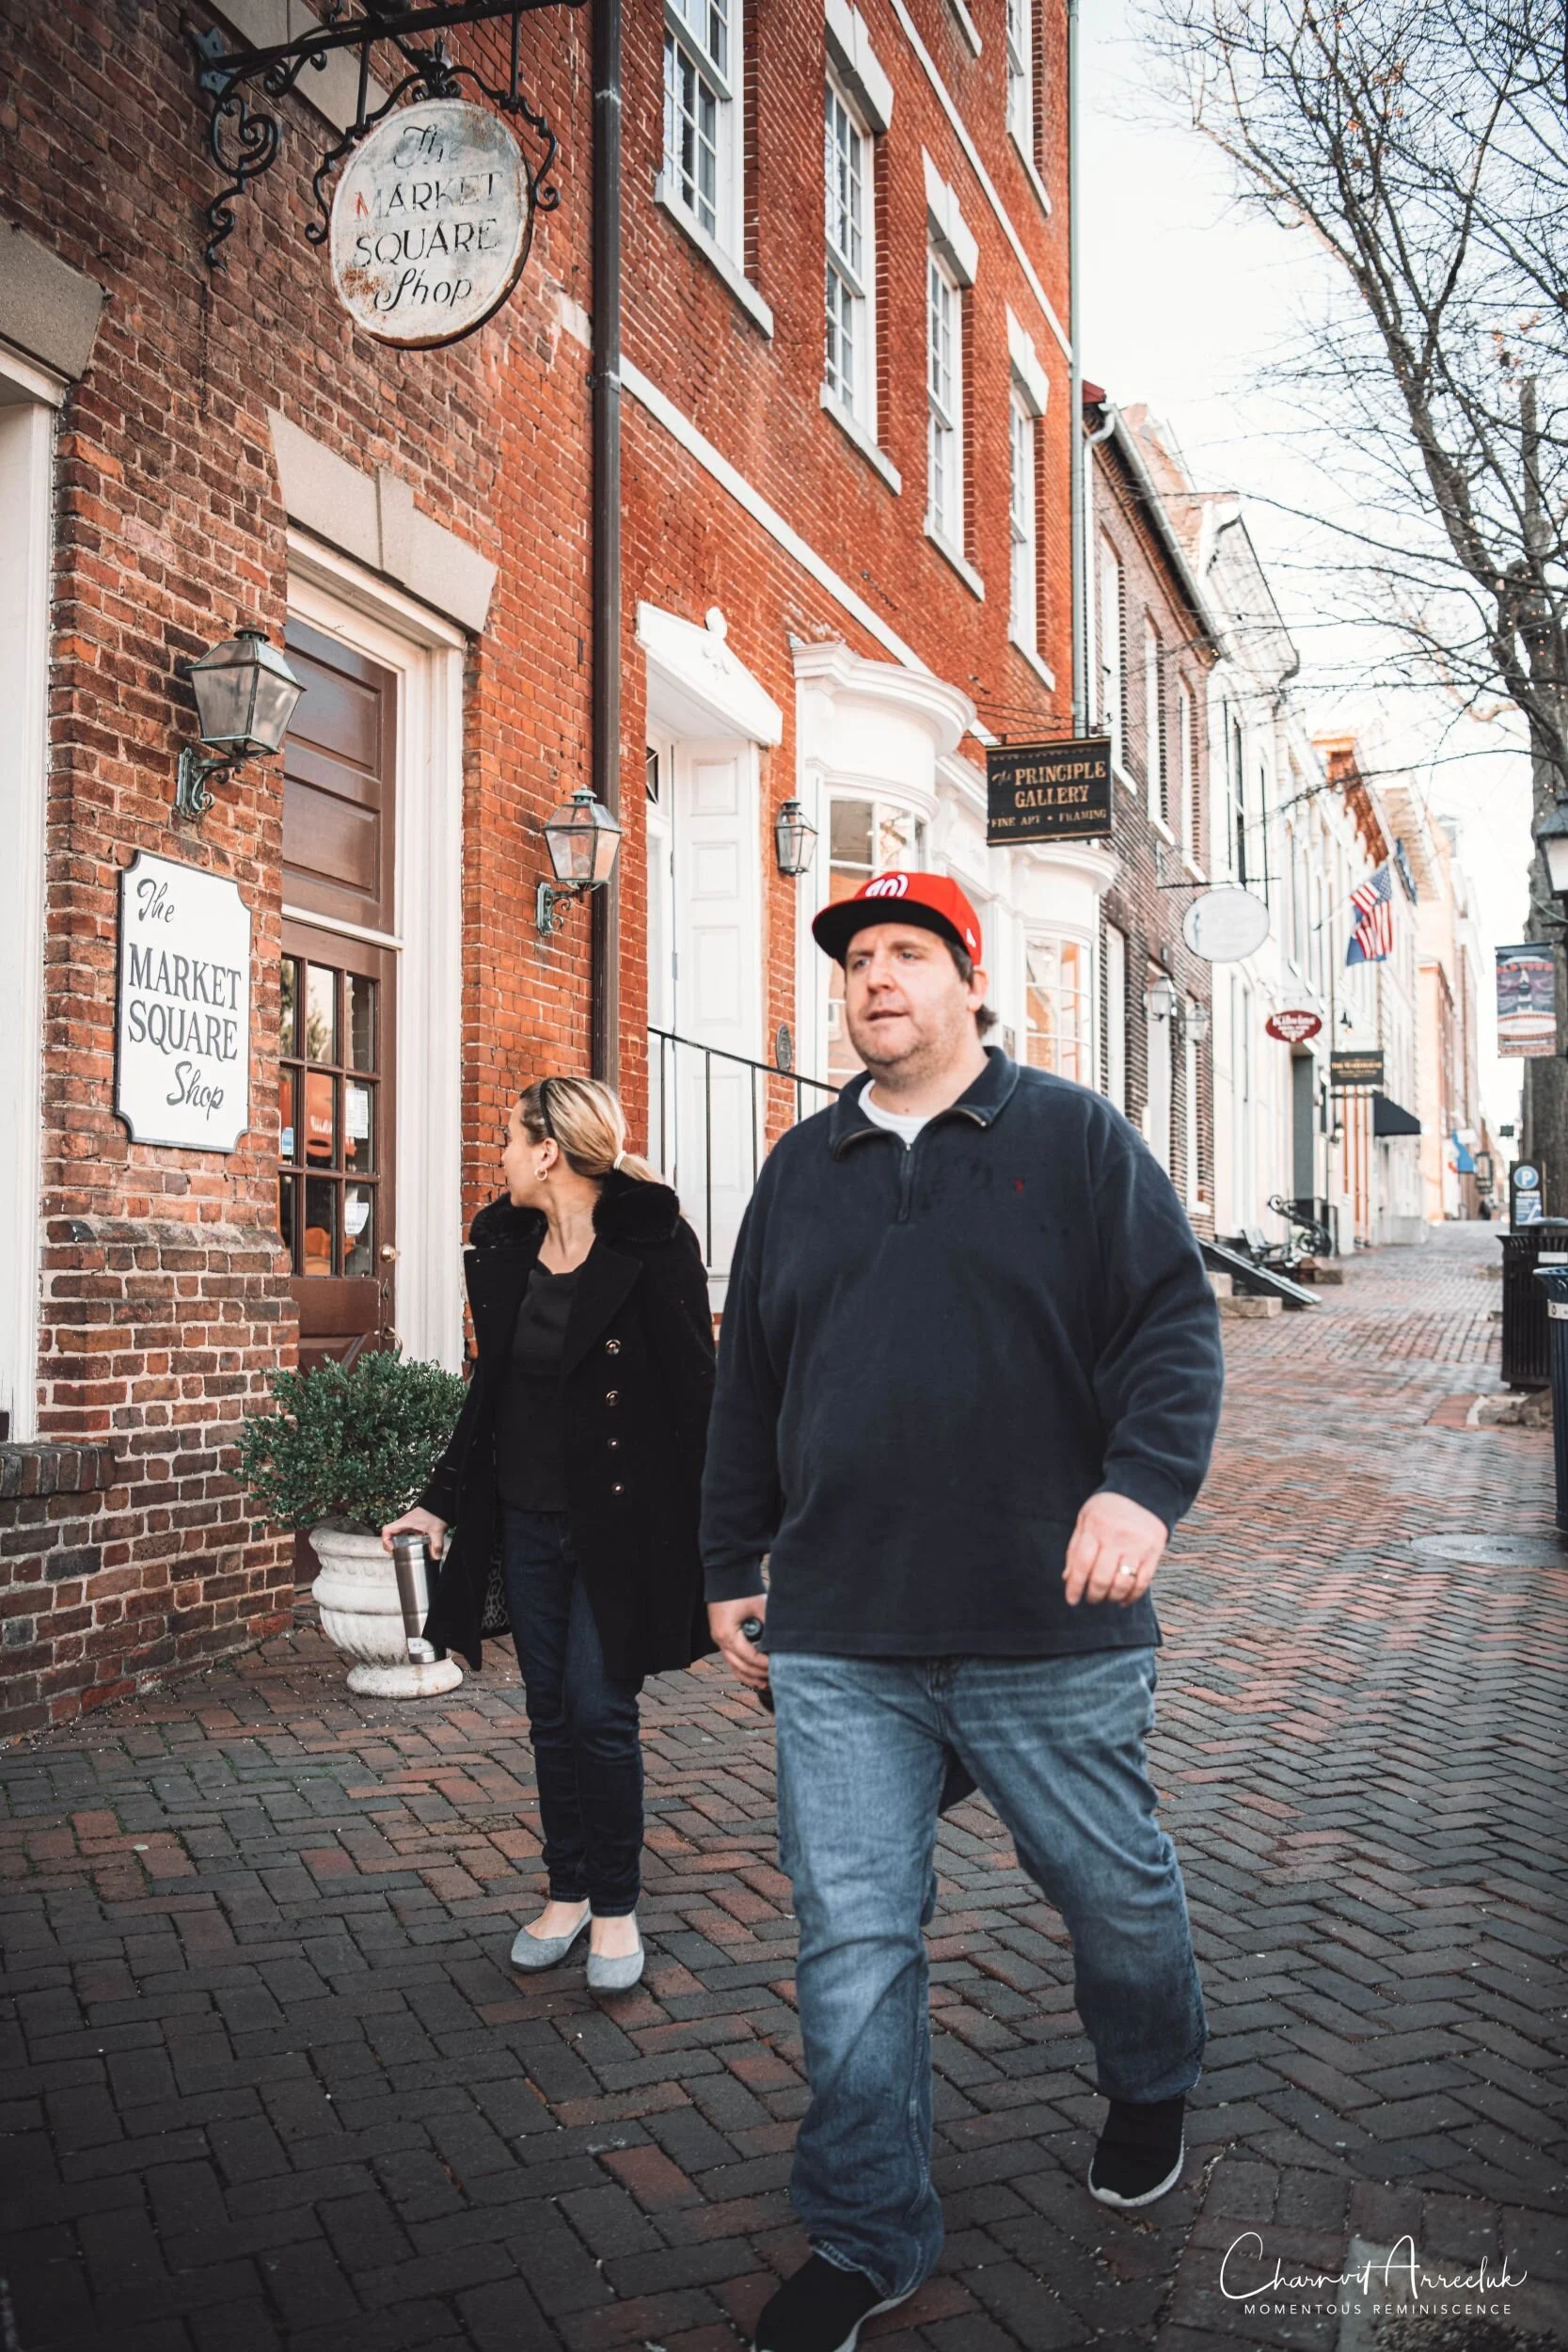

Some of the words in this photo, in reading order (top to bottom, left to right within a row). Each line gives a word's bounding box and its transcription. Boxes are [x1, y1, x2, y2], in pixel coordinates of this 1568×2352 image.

[393, 123, 463, 169] The
[354, 173, 503, 222] MARKET
[353, 218, 498, 267] SQUARE
[374, 268, 472, 311] Shop
[1015, 760, 1107, 787] PRINCIPLE
[1015, 785, 1090, 808] GALLERY
[991, 817, 1016, 828] FINE
[1059, 809, 1107, 822] FRAMING
[136, 878, 175, 923] The
[128, 943, 242, 1010] MARKET
[128, 999, 238, 1062] SQUARE
[166, 1061, 224, 1120] Shop
